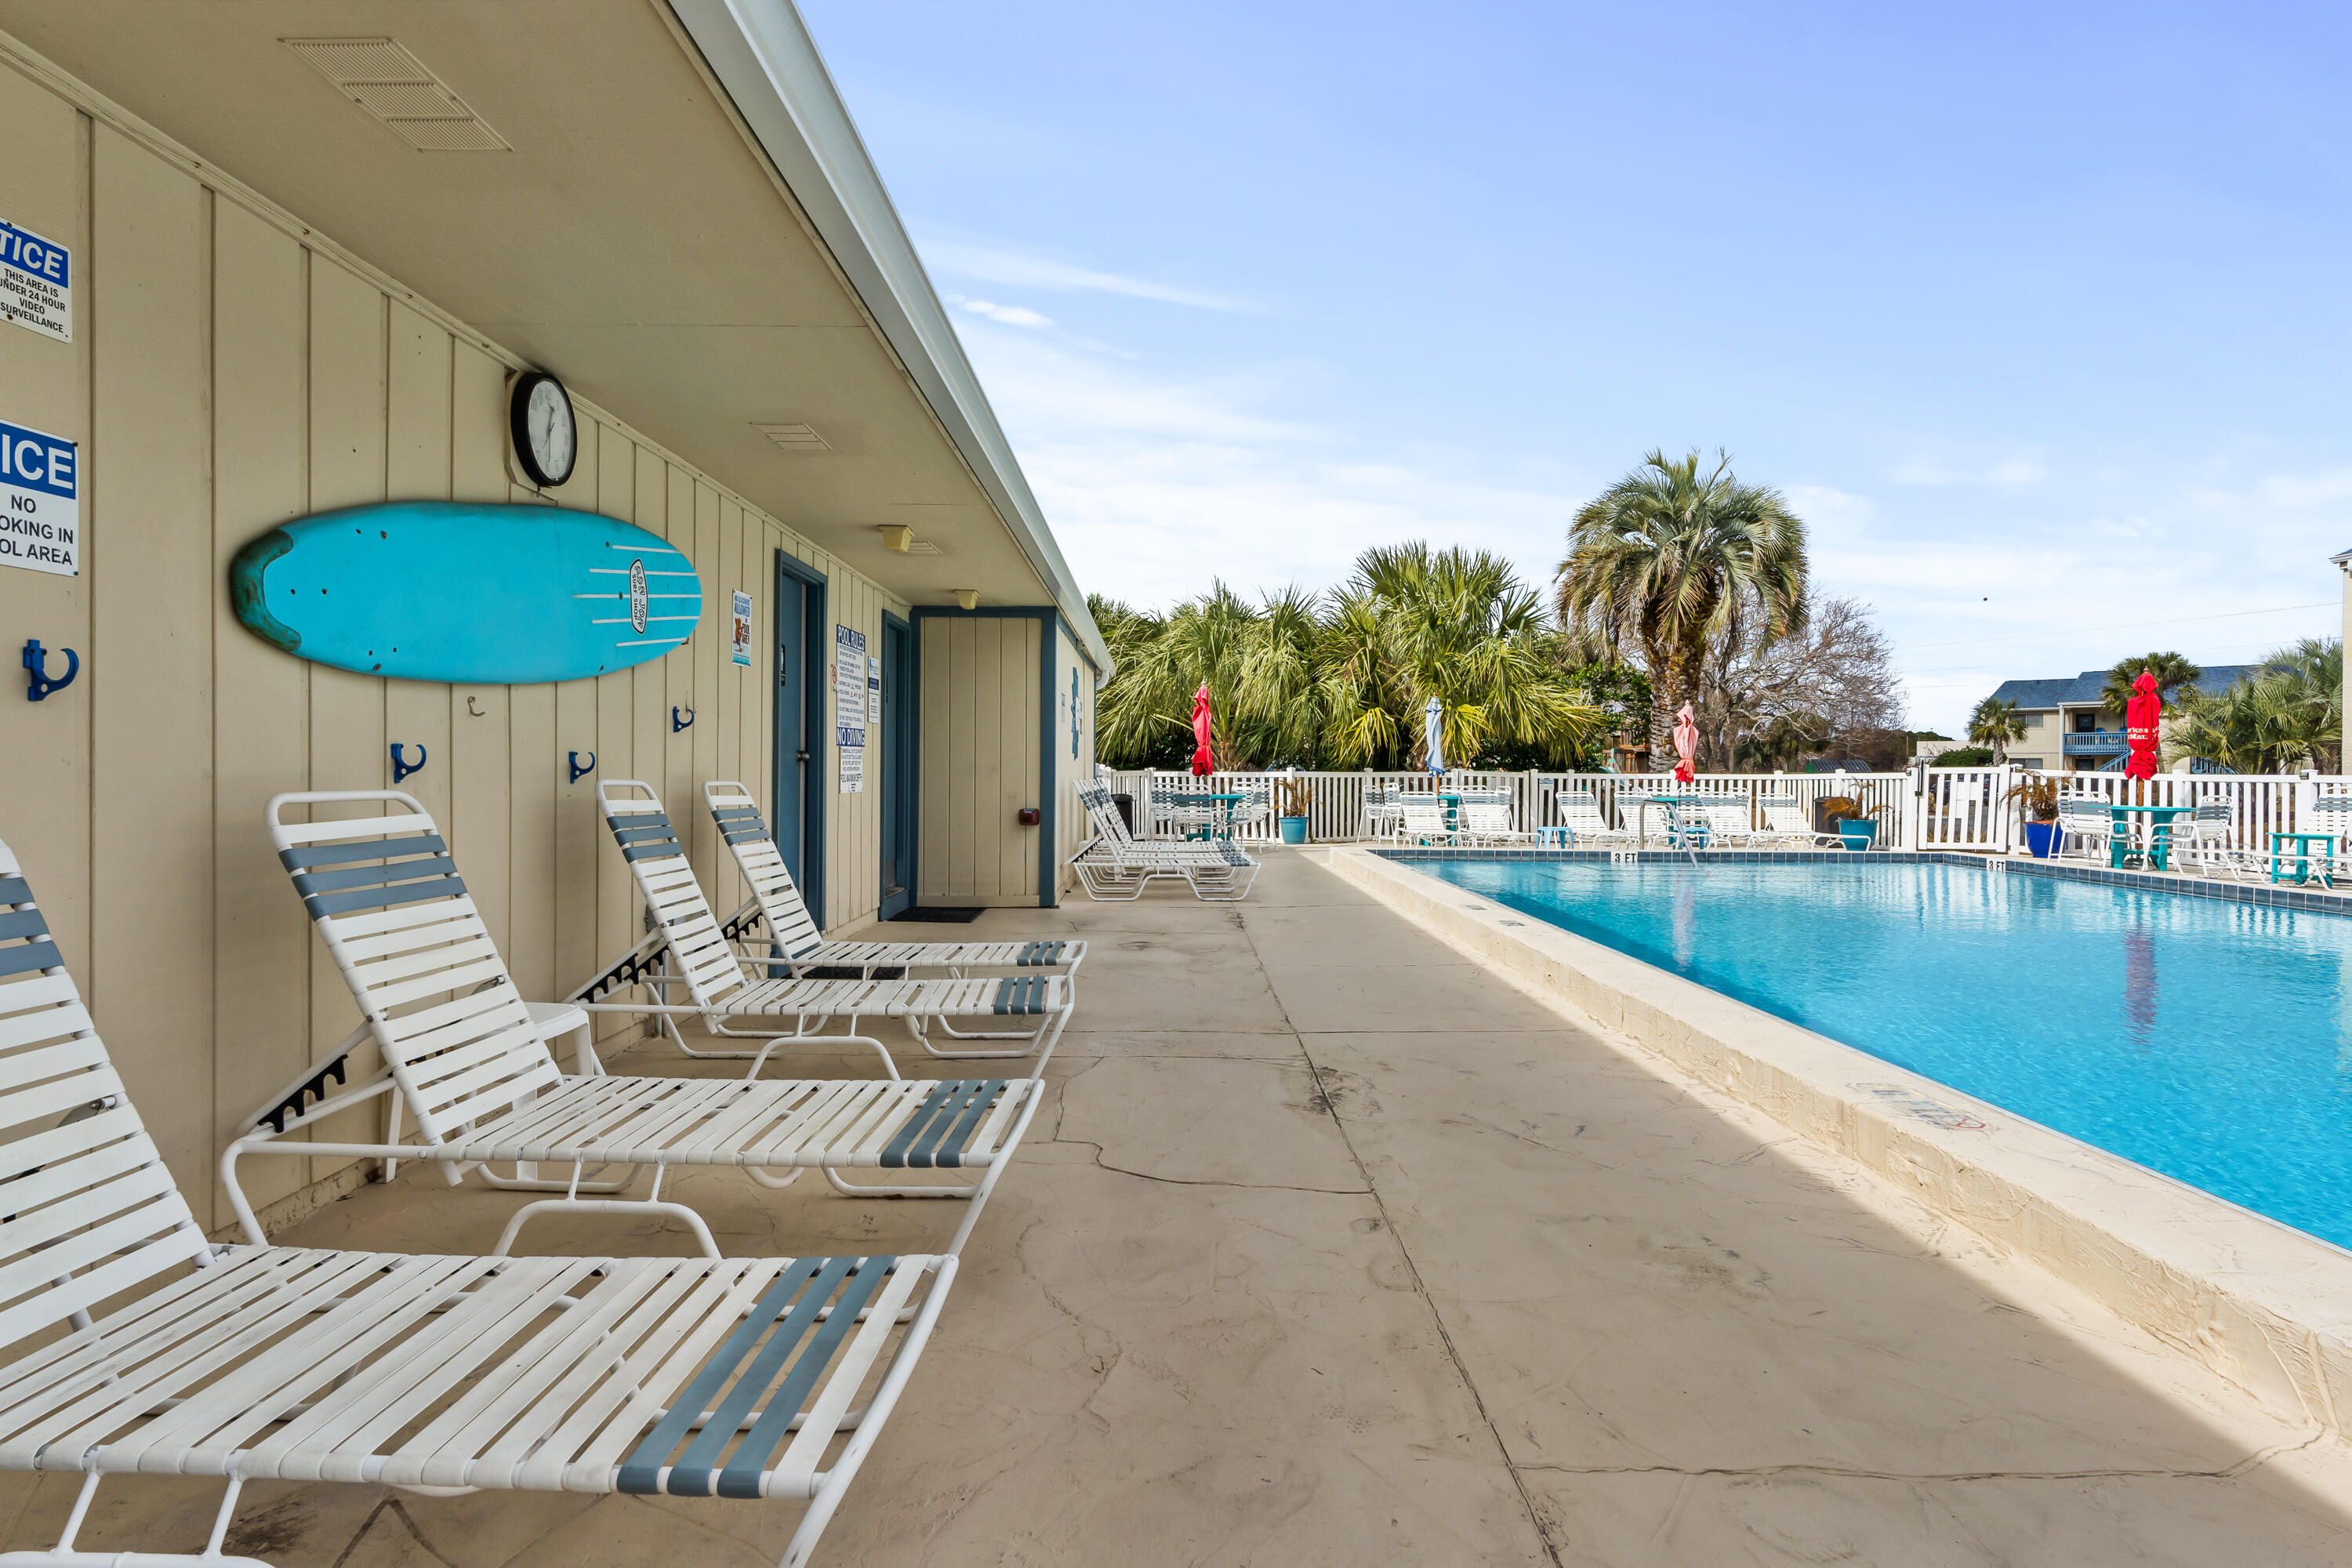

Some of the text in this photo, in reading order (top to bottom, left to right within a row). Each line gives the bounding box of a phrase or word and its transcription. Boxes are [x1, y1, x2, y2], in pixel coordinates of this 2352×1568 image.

[4, 268, 59, 298] THIS AREA IS
[20, 296, 45, 315] VIDEO
[28, 289, 40, 302] 24
[42, 295, 66, 313] HOUR
[0, 301, 64, 332] SURVEILLANCE
[2, 434, 74, 490] ICE
[11, 494, 36, 514] NO
[0, 515, 74, 544] OKING IN
[0, 539, 73, 566] OL AREA
[634, 565, 645, 596] RON
[734, 601, 751, 618] ALLOWED
[741, 633, 750, 645] AREA
[742, 623, 750, 635] POOL
[838, 626, 851, 645] POOL
[851, 631, 865, 652] RULES
[837, 728, 865, 746] NO DIVING
[1615, 853, 1637, 863] 3 FT
[1989, 860, 2005, 873] 3 FT
